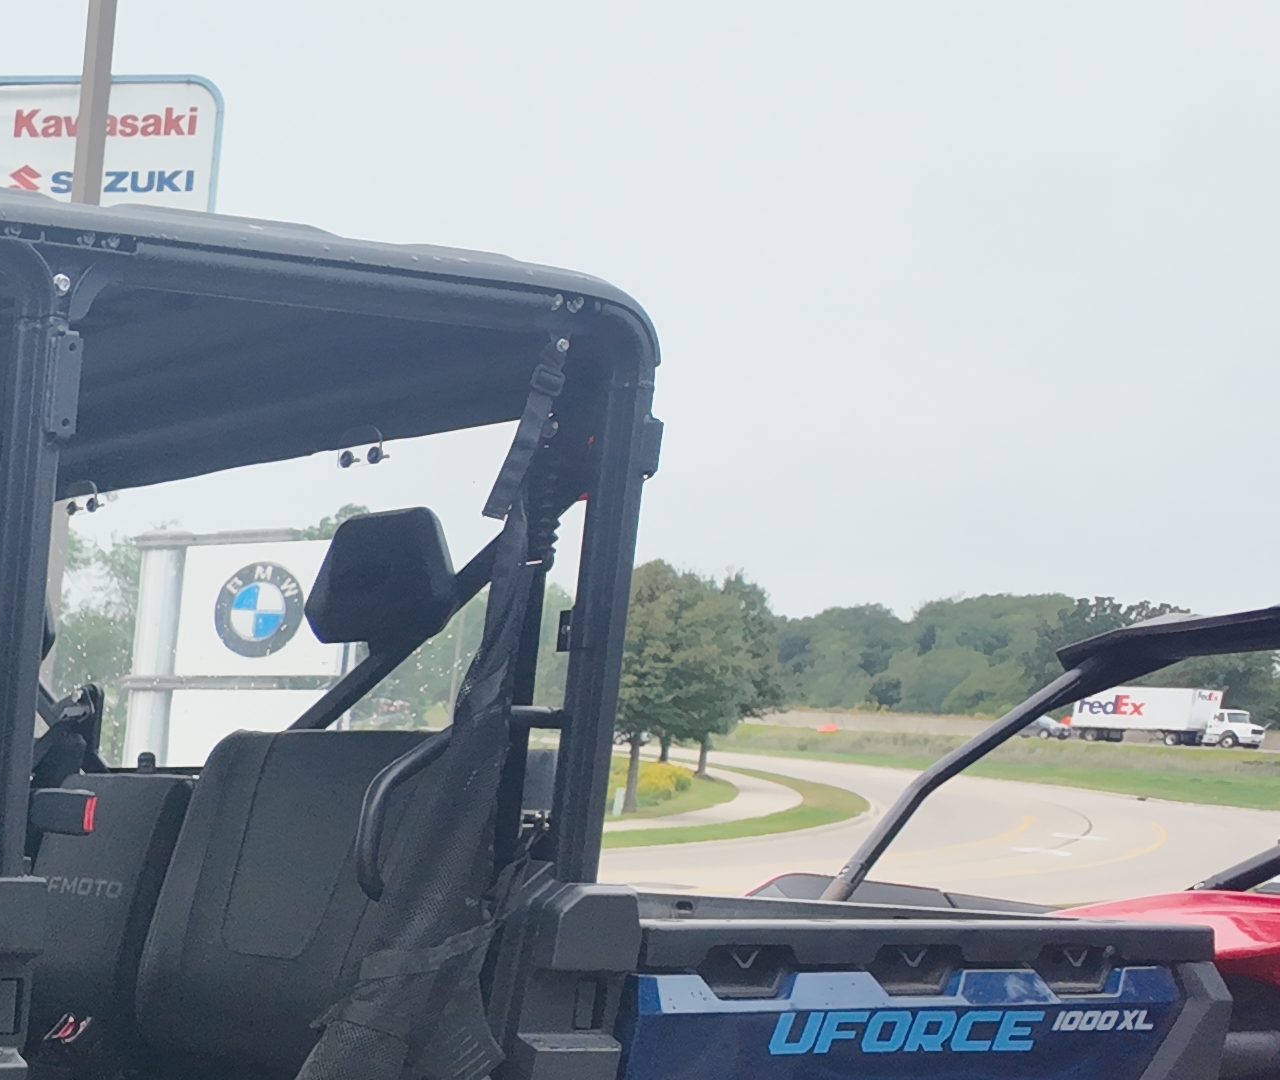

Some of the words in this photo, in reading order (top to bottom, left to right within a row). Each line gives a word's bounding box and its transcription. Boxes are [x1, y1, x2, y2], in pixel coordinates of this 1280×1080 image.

[50, 170, 195, 194] SZUKI
[226, 565, 299, 598] BMW
[1078, 694, 1146, 716] FedEx
[1197, 691, 1219, 702] FedEx
[44, 875, 123, 899] FMOTO
[769, 1010, 1044, 1055] UFORCE
